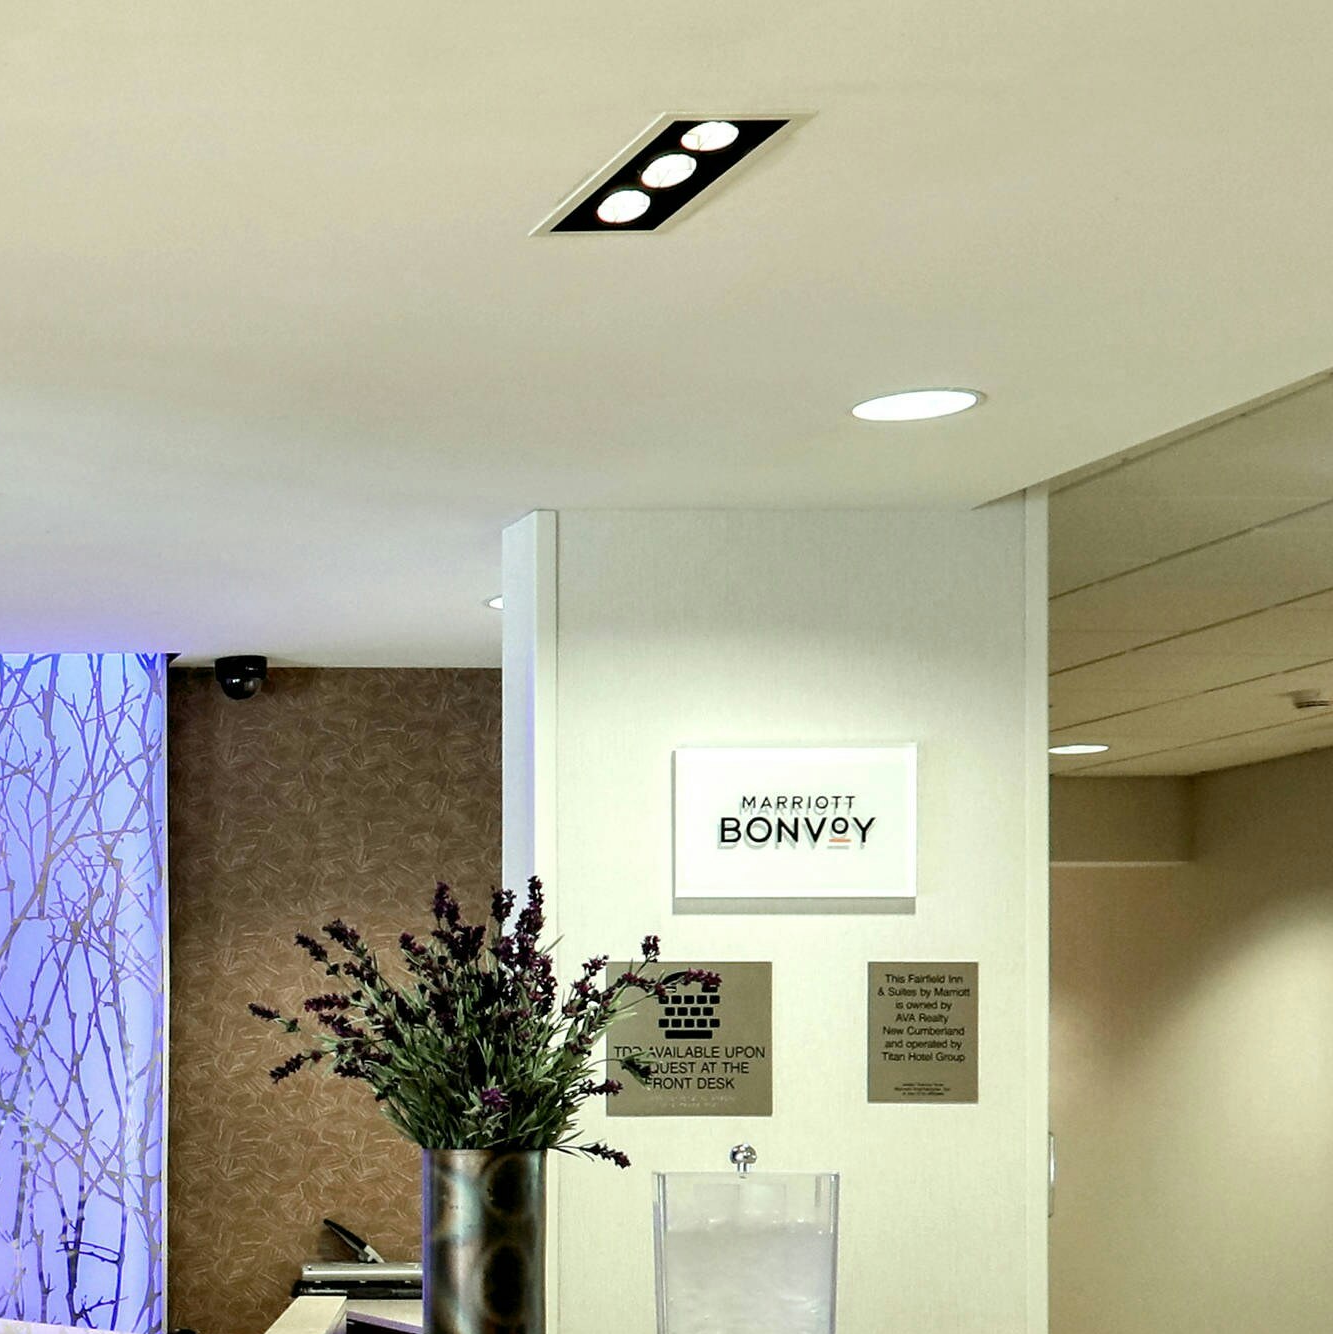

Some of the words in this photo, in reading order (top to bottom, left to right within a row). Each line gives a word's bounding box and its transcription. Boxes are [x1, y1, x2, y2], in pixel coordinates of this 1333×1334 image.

[741, 795, 856, 809] MARRIOTT
[720, 816, 876, 843] BONVOY
[885, 973, 906, 984] This
[908, 973, 946, 984] Fairfield
[948, 974, 964, 984] Inn
[877, 986, 885, 997] &
[888, 986, 917, 997] Suites
[920, 987, 932, 999] by
[934, 987, 971, 997] Marriott
[895, 1001, 904, 1010] is
[906, 1001, 938, 1010] owned
[940, 1001, 953, 1012] by
[895, 1013, 916, 1023] AVA
[918, 1013, 950, 1025] Realty
[883, 1026, 904, 1035] New
[906, 1025, 965, 1036] Cumberland
[885, 1039, 904, 1049] and
[906, 1039, 948, 1050] operated
[950, 1039, 963, 1050] by
[646, 1046, 720, 1059] AVAILABLE
[725, 1046, 766, 1059] UPON
[881, 1051, 905, 1062] Titan
[908, 1051, 933, 1062] Hotel
[935, 1051, 966, 1063] Group
[649, 1061, 696, 1075] QUEST
[700, 1061, 717, 1074] AT
[722, 1061, 750, 1074] THE
[645, 1076, 693, 1089] FRONT
[696, 1077, 736, 1090] DESK
